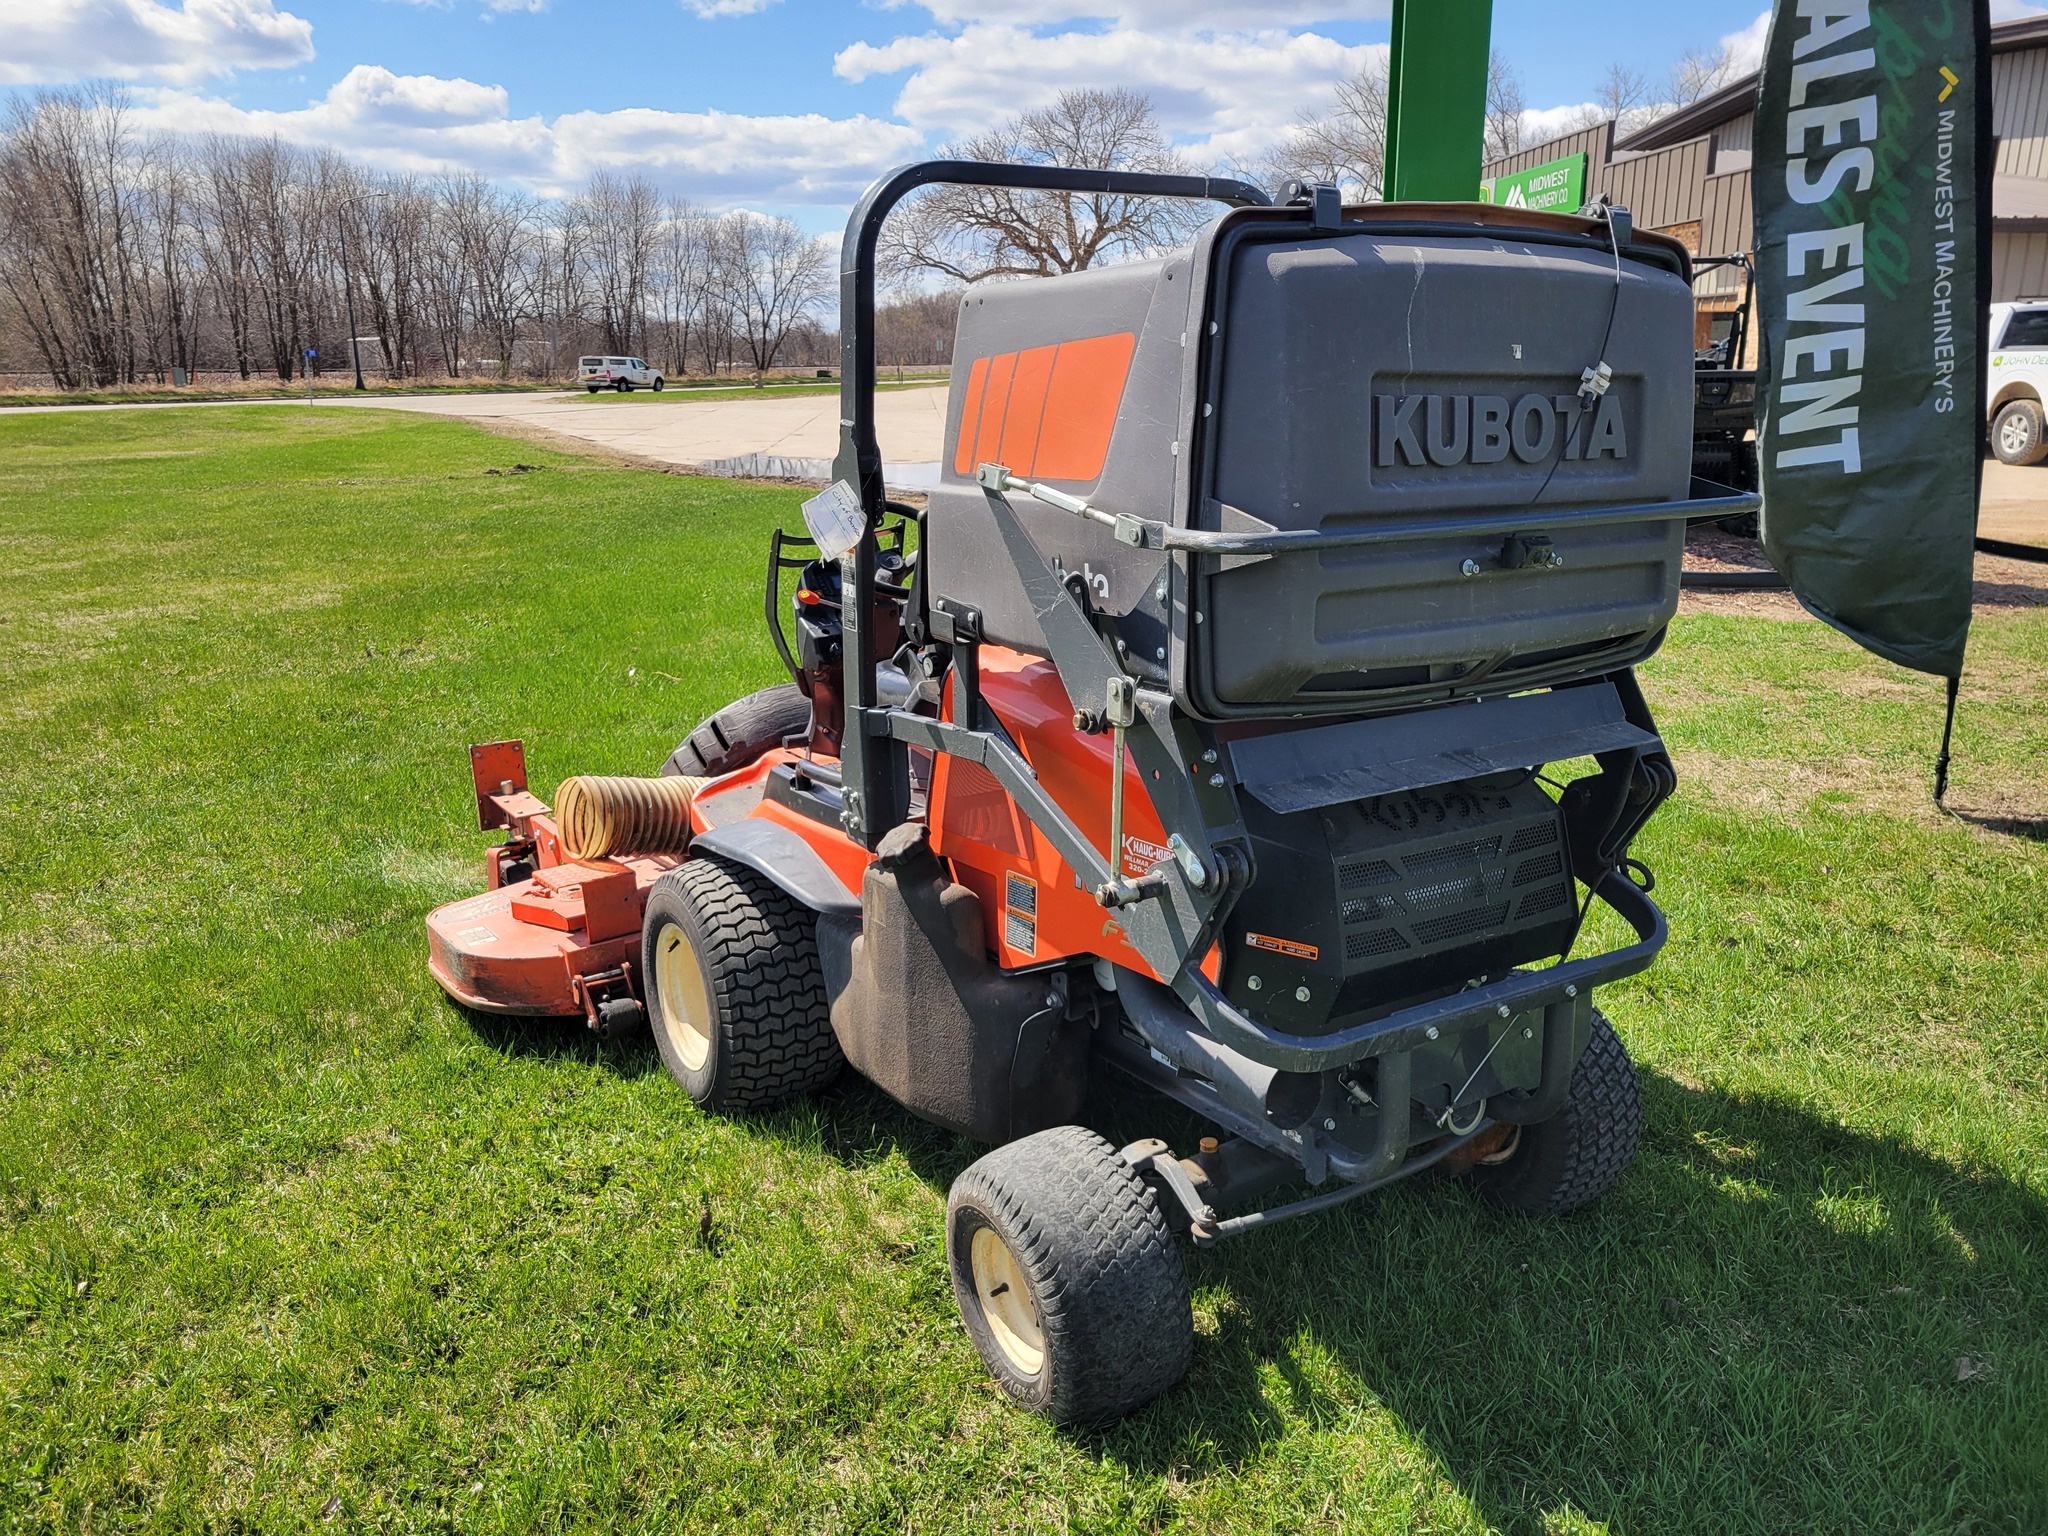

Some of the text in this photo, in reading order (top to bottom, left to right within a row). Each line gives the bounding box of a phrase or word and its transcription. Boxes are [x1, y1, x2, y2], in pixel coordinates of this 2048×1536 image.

[1529, 169, 1570, 193] MIDWEST
[1934, 109, 1956, 233] MIDWEST
[1776, 222, 1866, 474] EVENT
[2003, 356, 2029, 366] JOHN
[1374, 393, 1627, 467] KUBOTA
